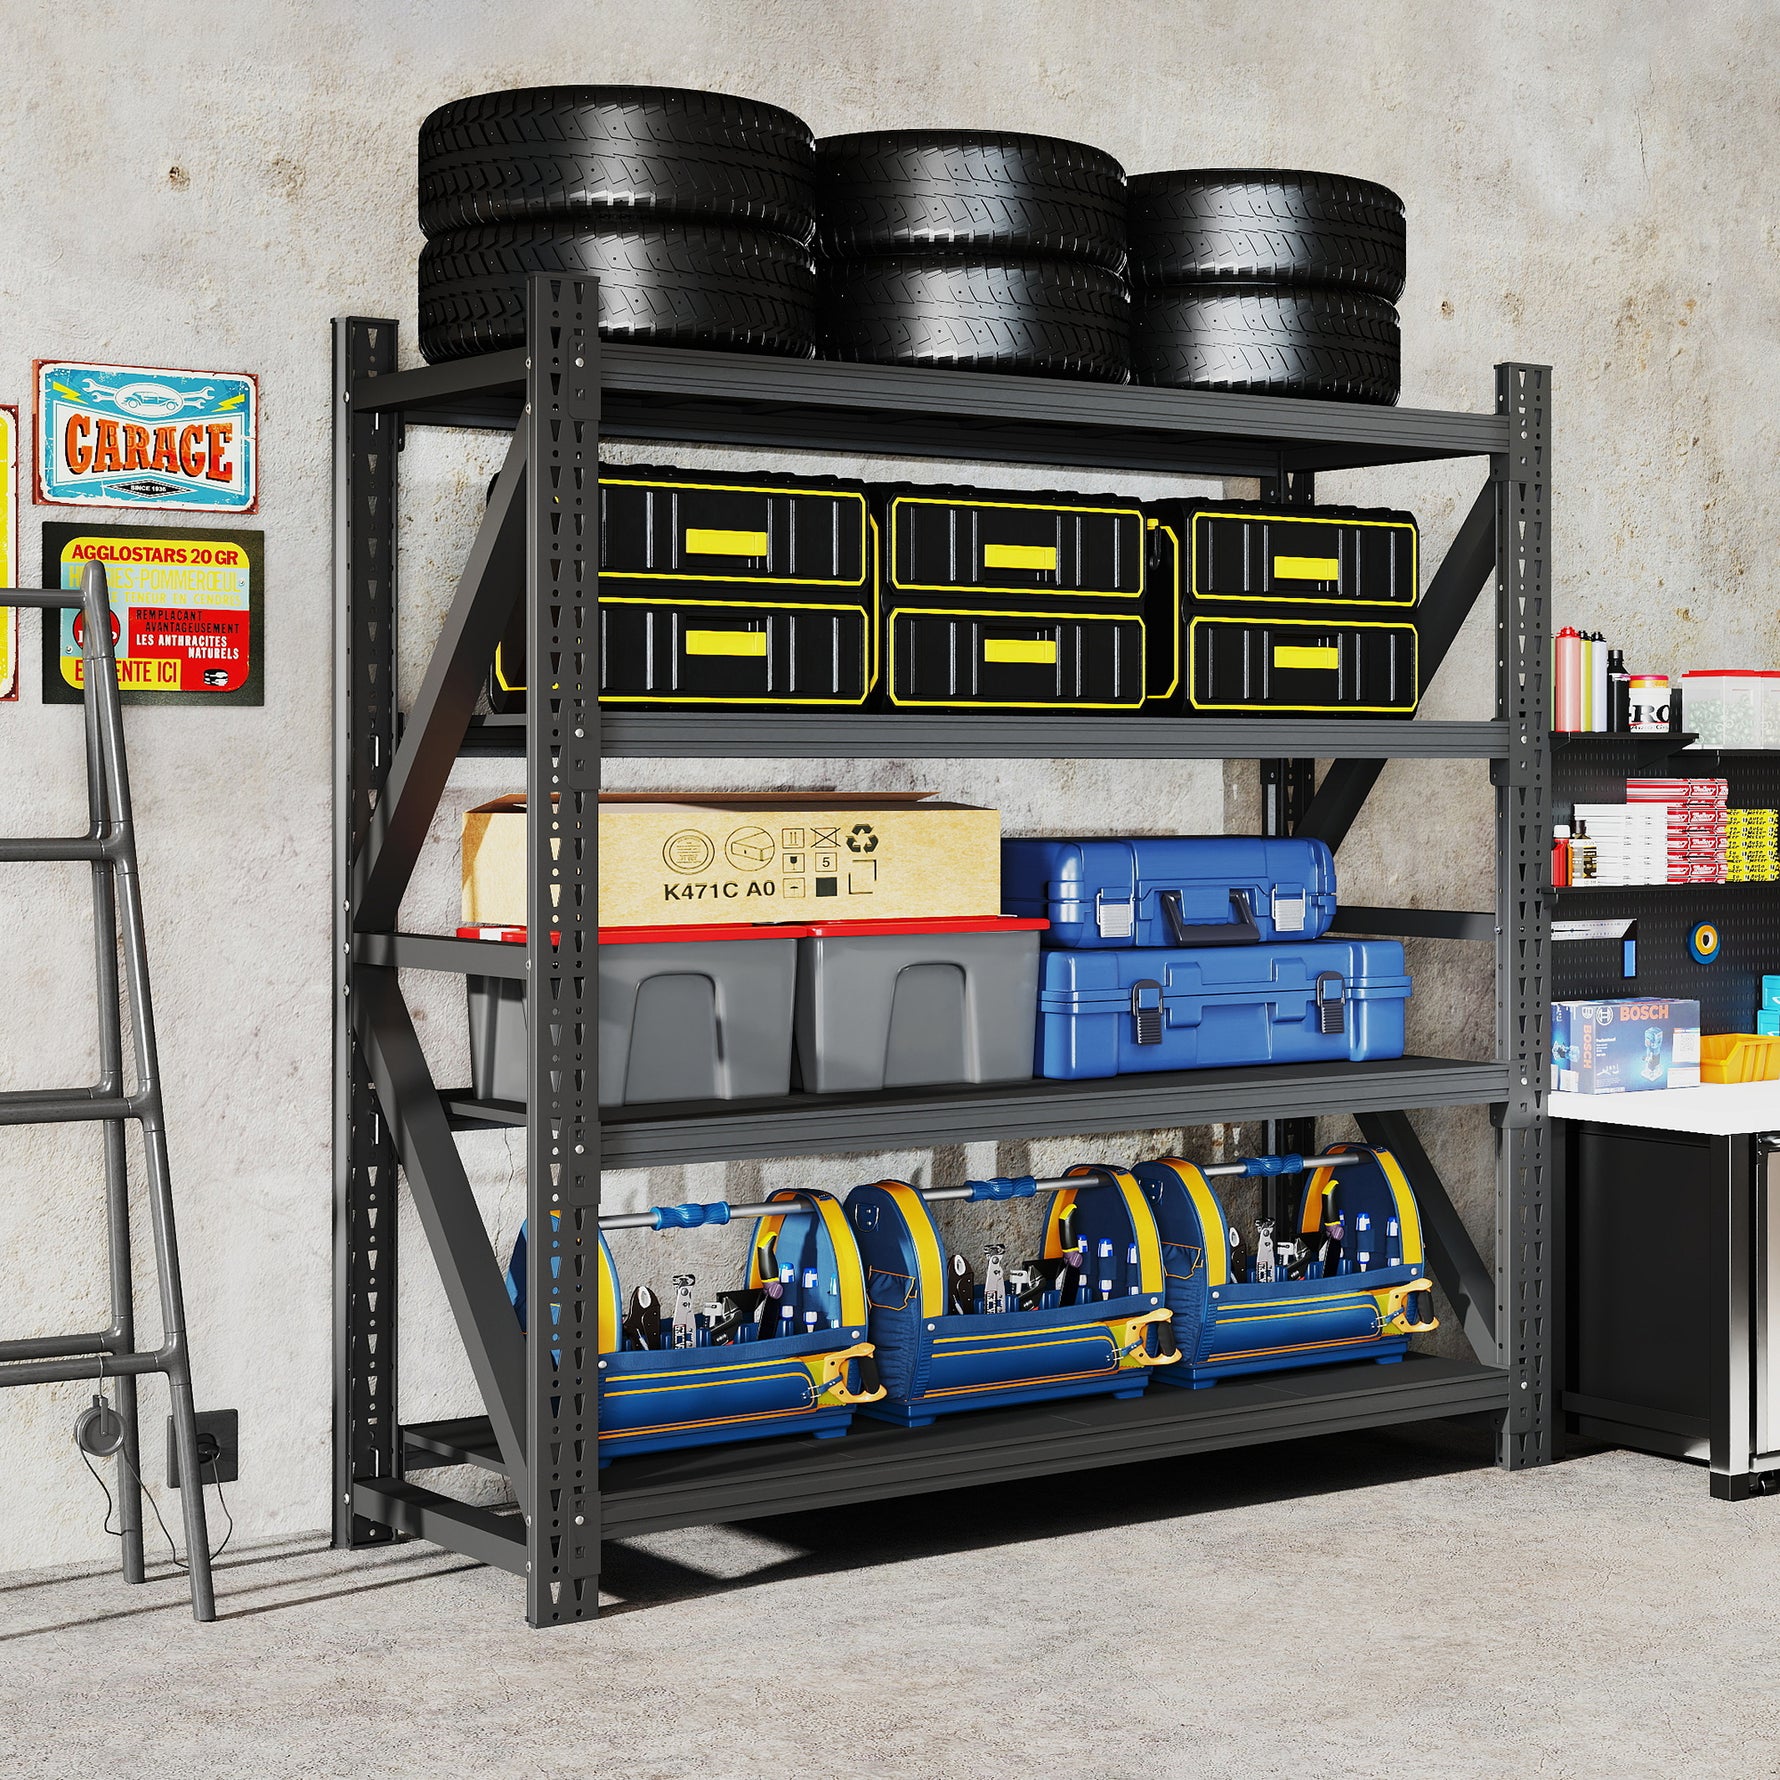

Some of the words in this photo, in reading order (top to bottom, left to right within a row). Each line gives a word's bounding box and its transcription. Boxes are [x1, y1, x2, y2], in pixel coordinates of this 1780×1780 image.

[65, 413, 233, 482] GARAGE
[71, 544, 188, 564] AGGLOSTARS
[190, 548, 213, 565] 20
[214, 549, 239, 566] GR
[124, 591, 167, 605] TENEUR
[173, 592, 187, 605] EN
[193, 593, 241, 607] CENDRES
[145, 621, 240, 634] AVANTAGEUSEMENT
[136, 633, 155, 646] LES
[158, 634, 227, 648] ANTHRACITES
[188, 647, 240, 660] NATURELS
[115, 660, 152, 682] ENTE
[157, 661, 177, 683] ICI
[822, 856, 831, 868] 5
[663, 882, 740, 901] K471C
[746, 880, 776, 897] A0
[1619, 1004, 1669, 1022] BOSCH
[1583, 1024, 1593, 1069] BOSCH
